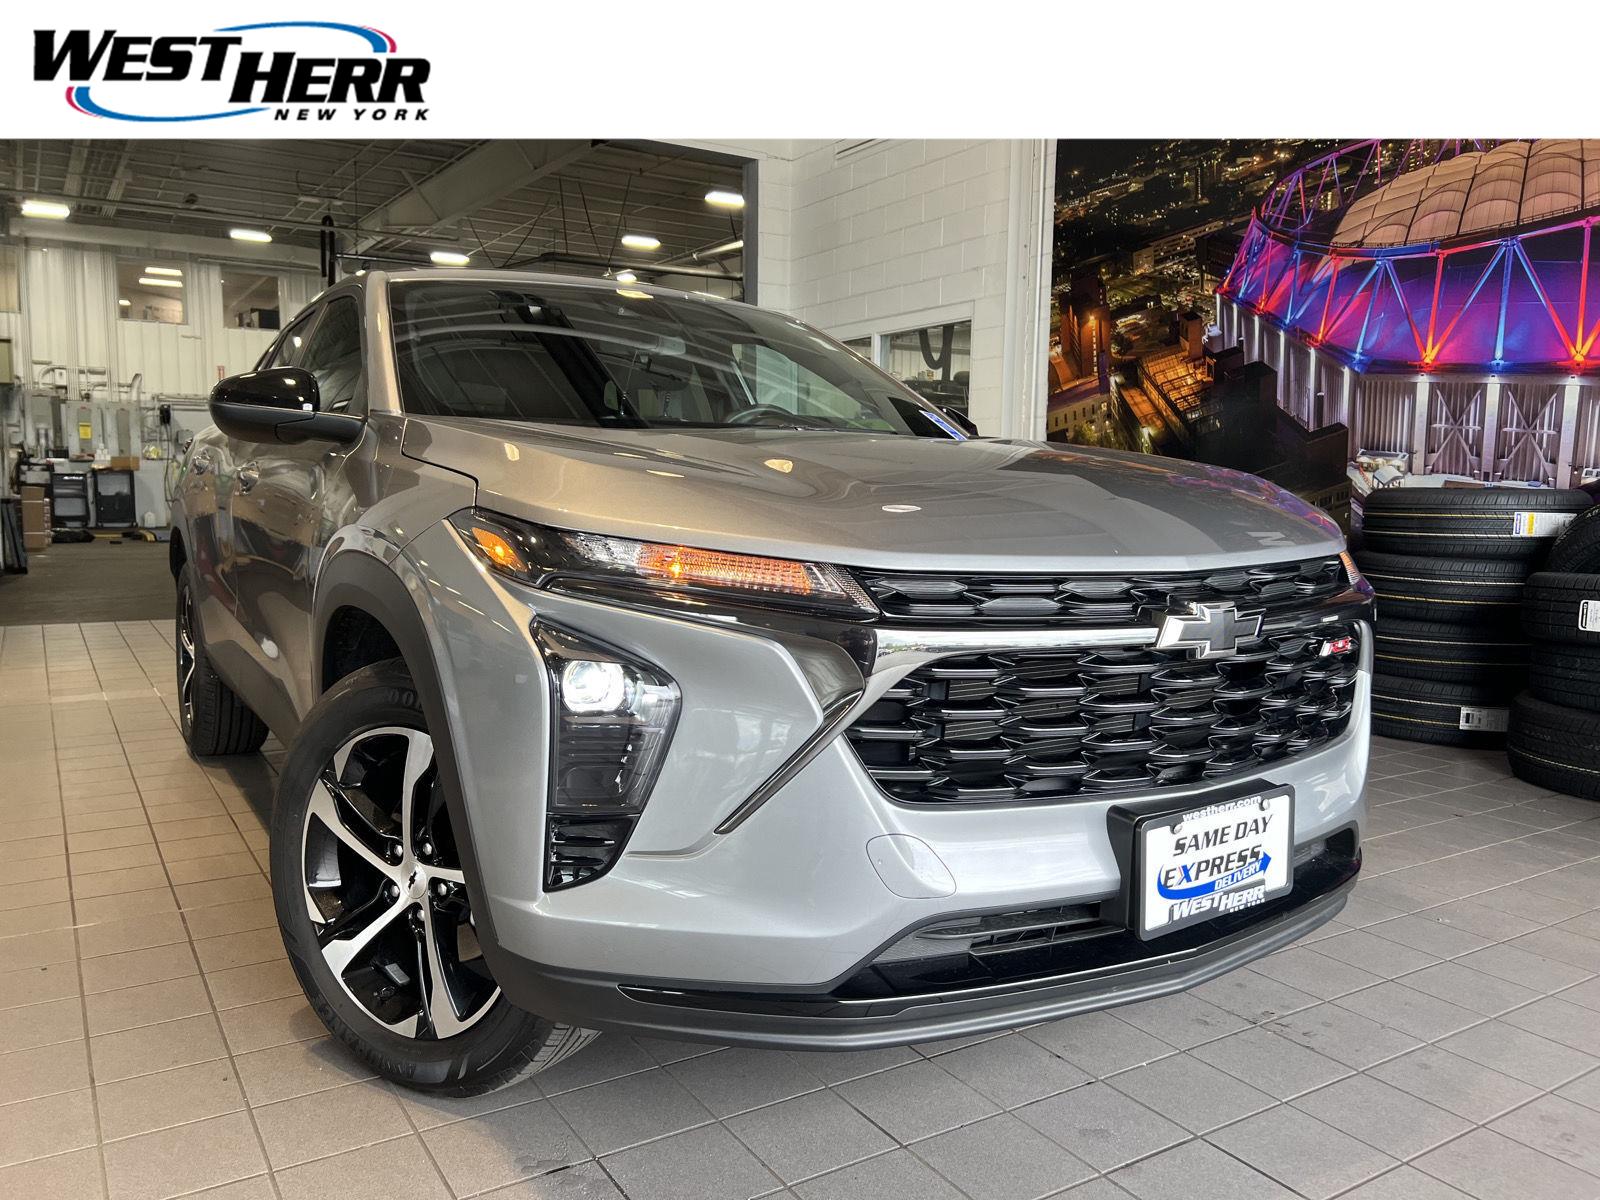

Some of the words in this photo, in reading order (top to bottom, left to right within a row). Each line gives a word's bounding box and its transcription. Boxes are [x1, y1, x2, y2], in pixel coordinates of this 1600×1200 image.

[1182, 796, 1262, 822] westherr.com
[1173, 825, 1232, 857] SAME
[1234, 814, 1273, 841] DAY
[1163, 844, 1262, 889] EXPRESS
[1214, 860, 1262, 891] DELIVERY
